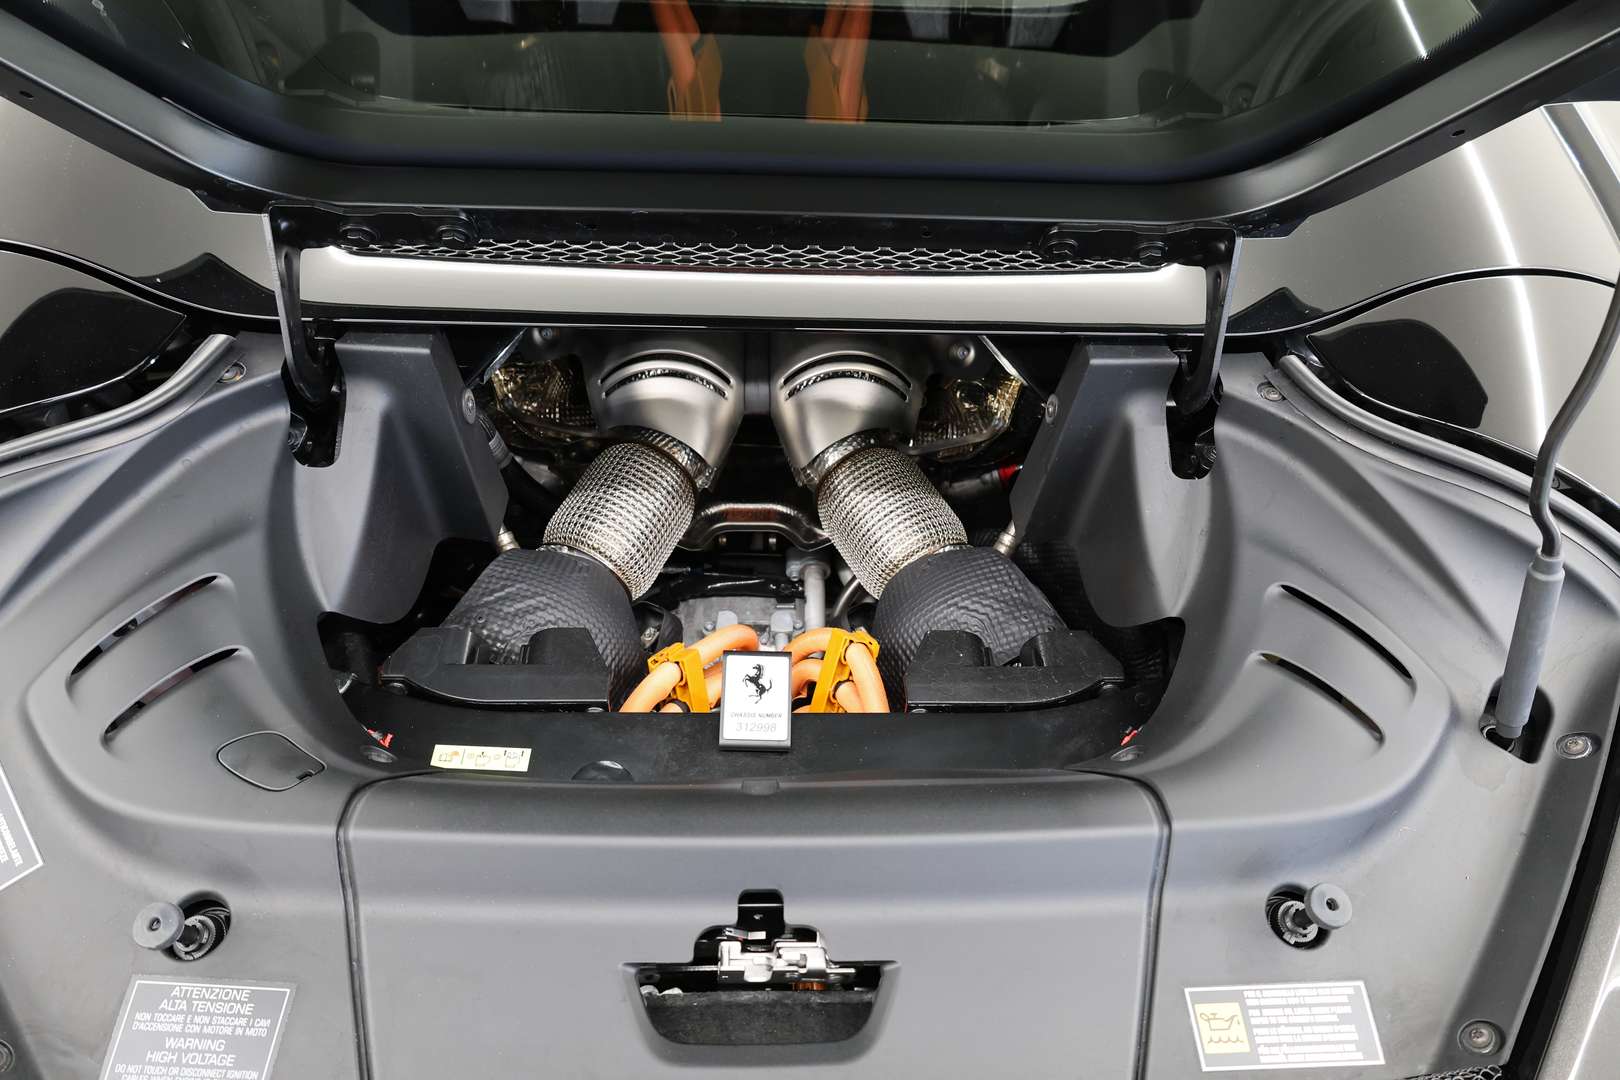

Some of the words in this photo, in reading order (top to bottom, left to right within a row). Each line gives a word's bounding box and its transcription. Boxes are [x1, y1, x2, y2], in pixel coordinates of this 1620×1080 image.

[735, 721, 777, 733] 312998
[170, 986, 252, 1001] ATTENZIONE
[158, 1000, 187, 1011] ALTA
[191, 1001, 255, 1015] TENSIONE
[134, 1011, 152, 1021] NON
[153, 1012, 186, 1023] TOCCARE
[187, 1014, 193, 1023] E
[193, 1014, 210, 1024] NON
[211, 1015, 249, 1026] STACCARE
[254, 1018, 271, 1027] CAVI
[132, 1021, 184, 1033] D'ACCENSIONE
[185, 1024, 201, 1033] CON
[202, 1025, 234, 1036] MOTORE
[234, 1027, 244, 1036] IN
[244, 1027, 268, 1037] MOTO
[165, 1037, 226, 1051] WARNING
[146, 1050, 178, 1063] HIGH
[181, 1052, 236, 1067] VOLTAGE
[114, 1063, 127, 1073] DO
[126, 1063, 142, 1074] NOT
[143, 1065, 168, 1075] TOUCH
[168, 1066, 179, 1075] OR
[179, 1067, 227, 1079] DISCONNECT
[226, 1069, 260, 1080] IGNITION
